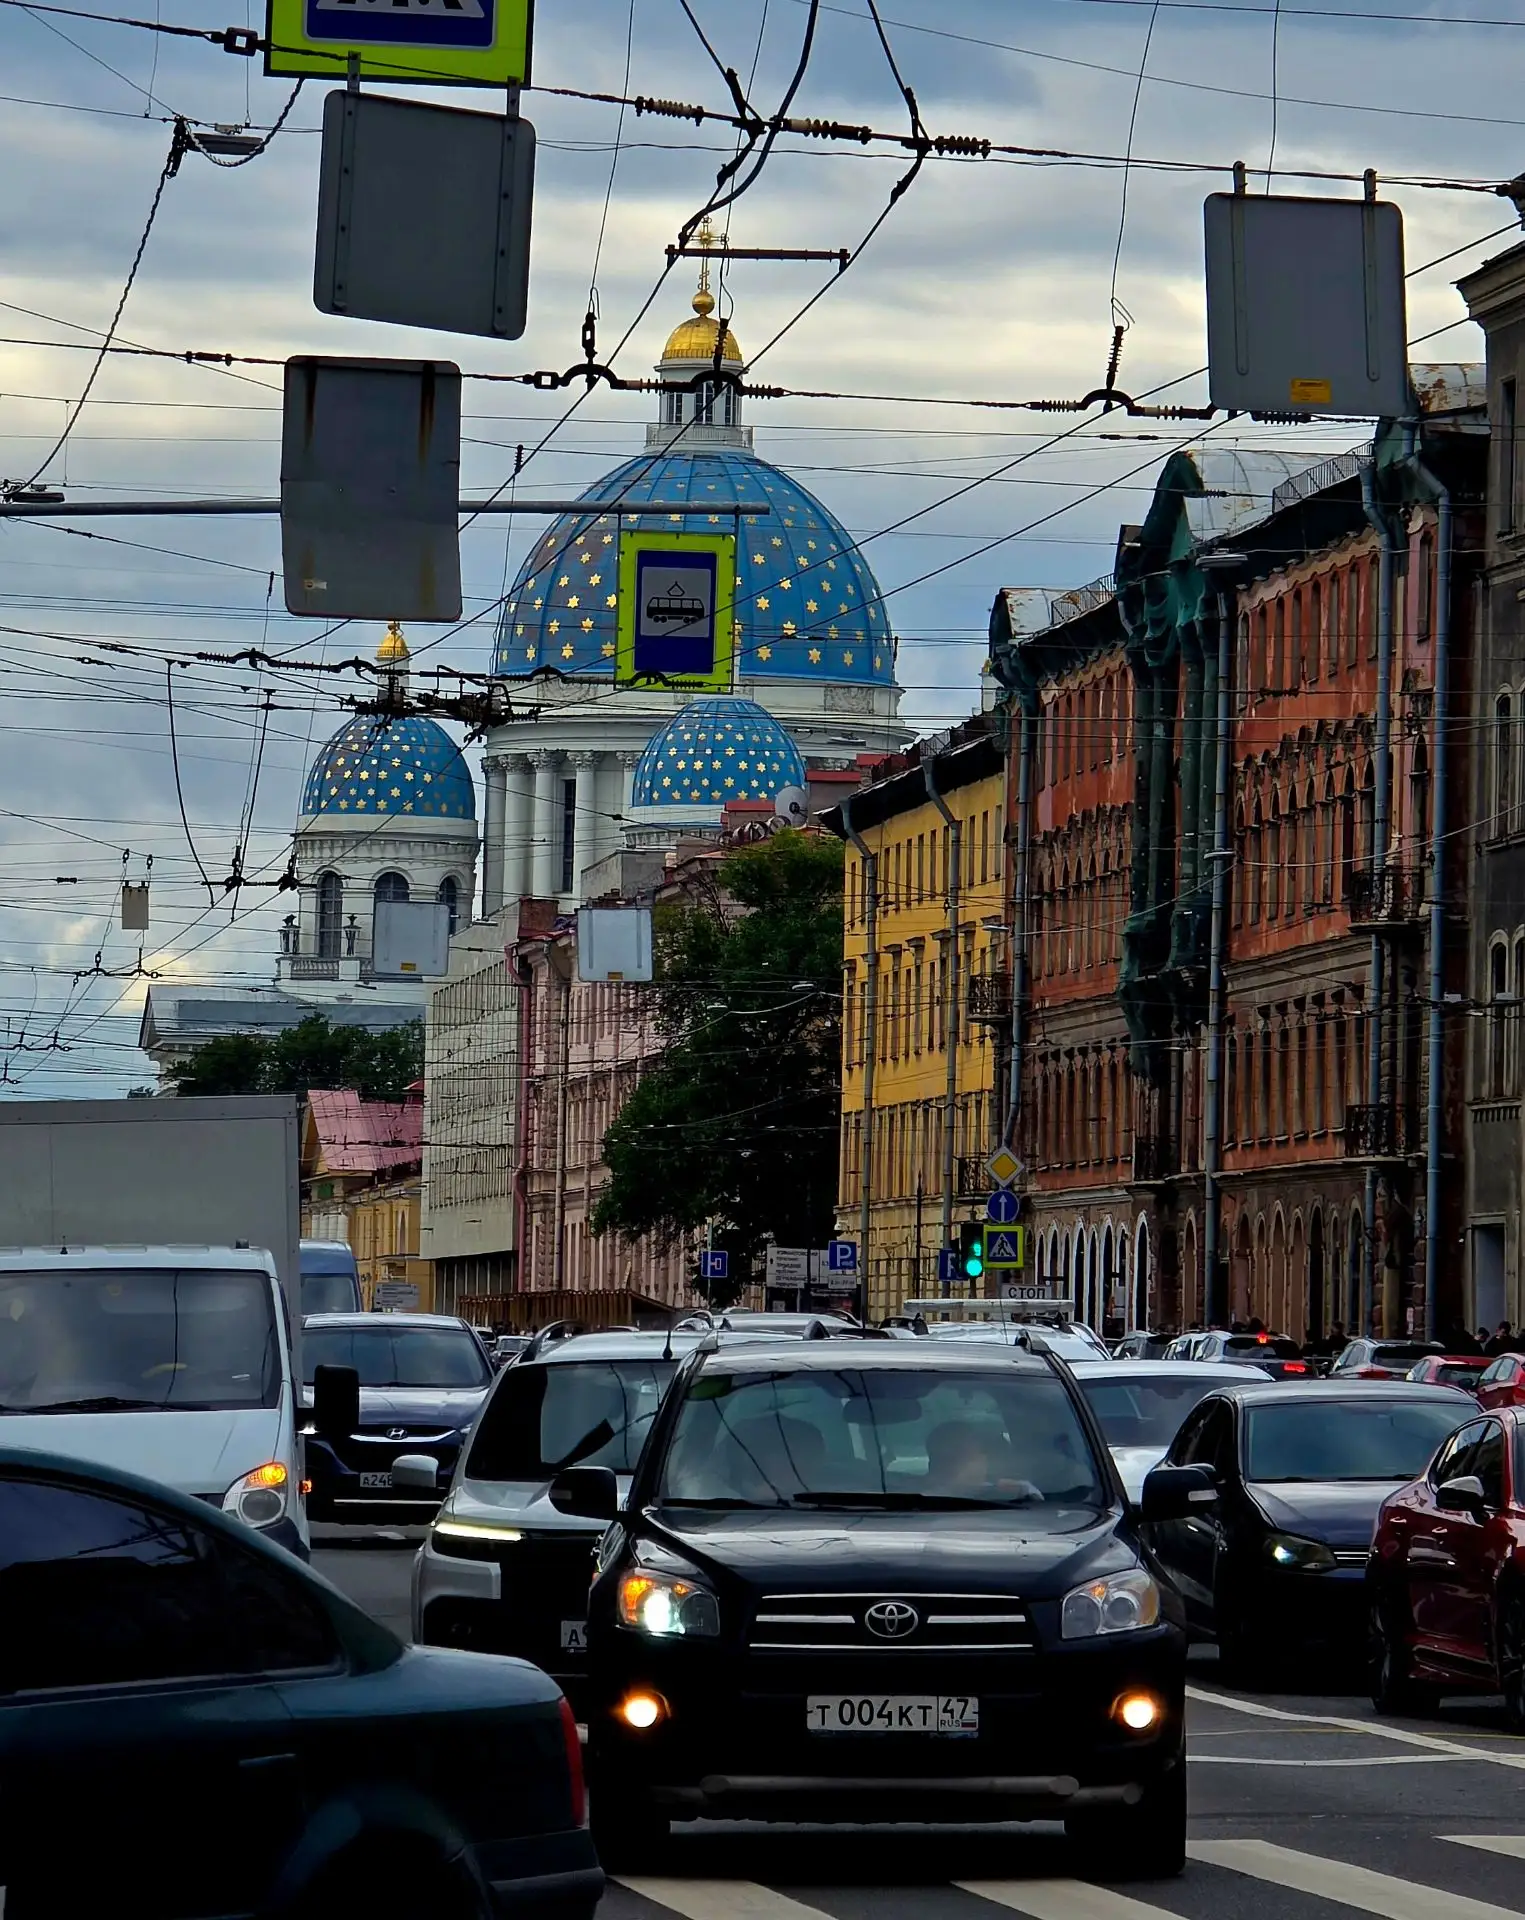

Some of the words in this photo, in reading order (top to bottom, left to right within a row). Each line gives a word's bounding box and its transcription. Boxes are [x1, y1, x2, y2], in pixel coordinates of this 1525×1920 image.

[836, 1244, 852, 1267] P
[1008, 1287, 1046, 1299] СТОП
[942, 1698, 969, 1719] 47
[940, 1719, 961, 1728] RUS
